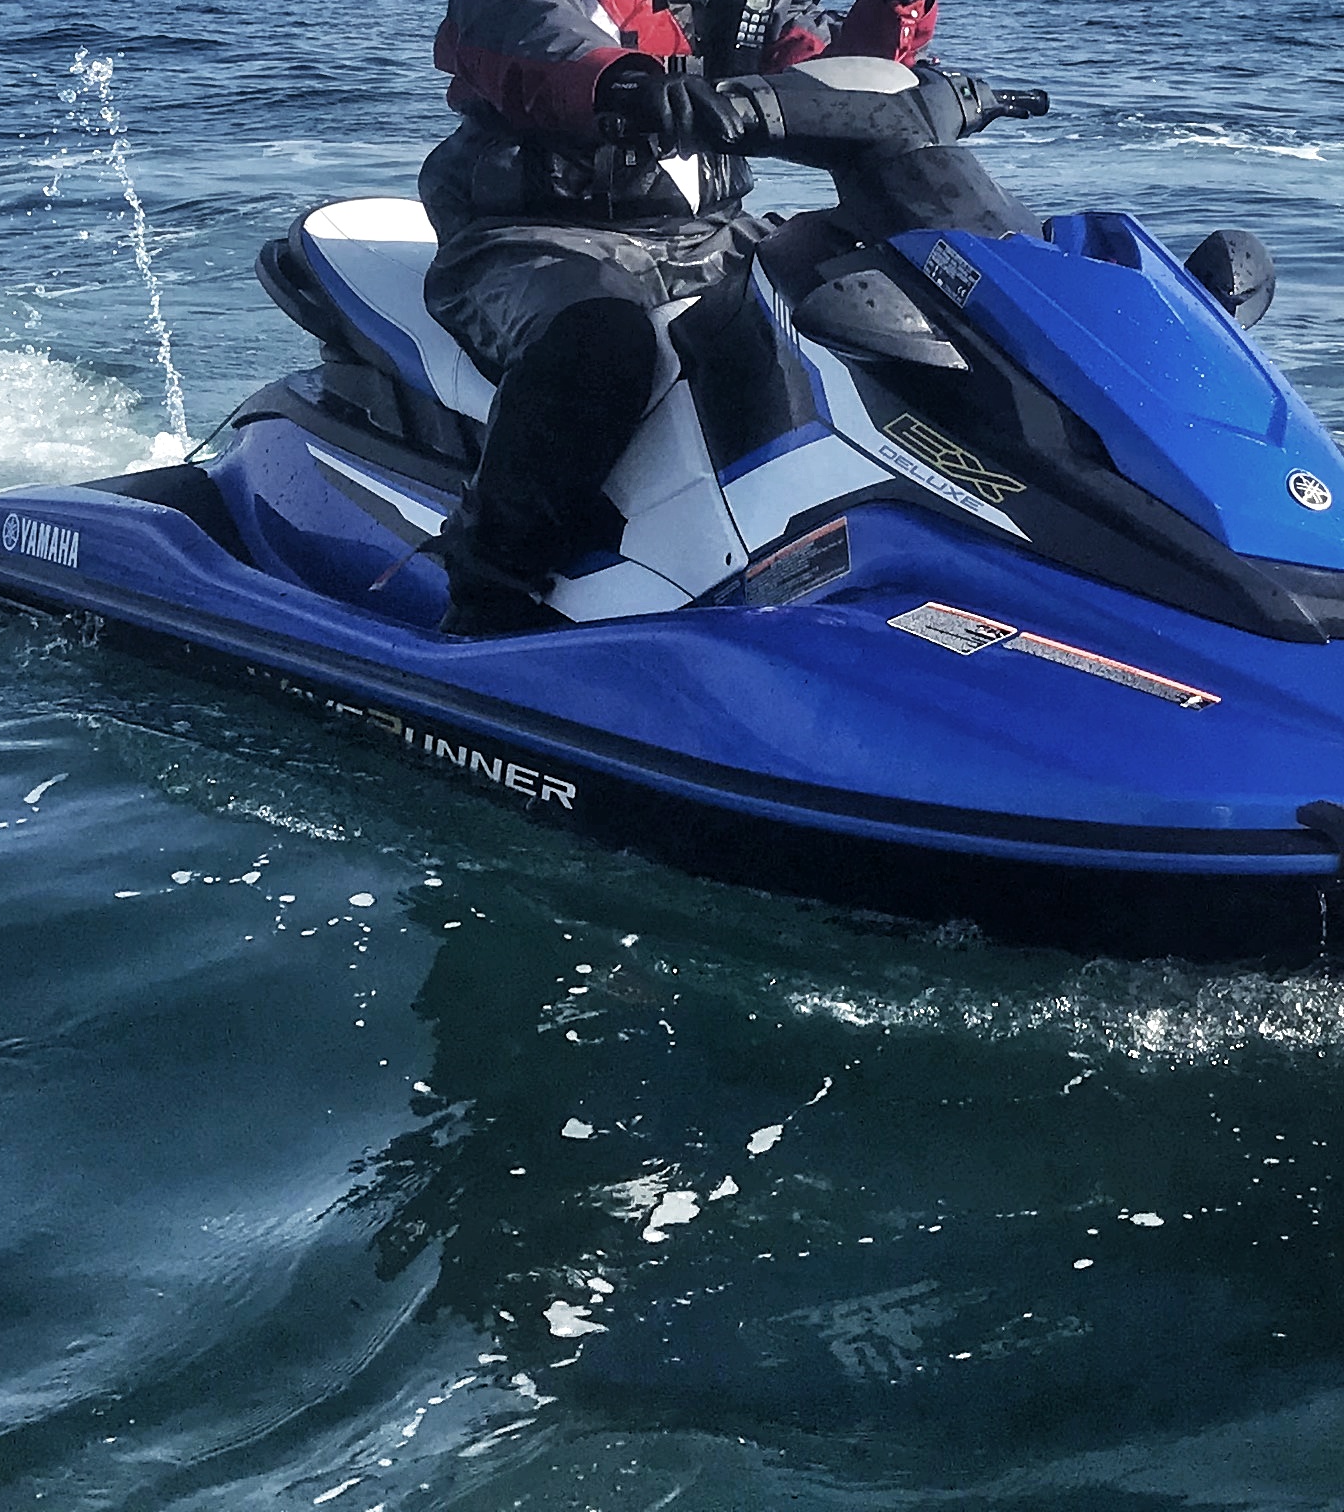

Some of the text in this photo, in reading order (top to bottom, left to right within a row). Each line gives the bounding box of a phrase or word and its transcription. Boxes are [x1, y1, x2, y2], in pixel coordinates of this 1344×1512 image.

[878, 445, 984, 512] DELUXE
[883, 412, 1027, 503] EX
[21, 518, 79, 568] YAMAHA
